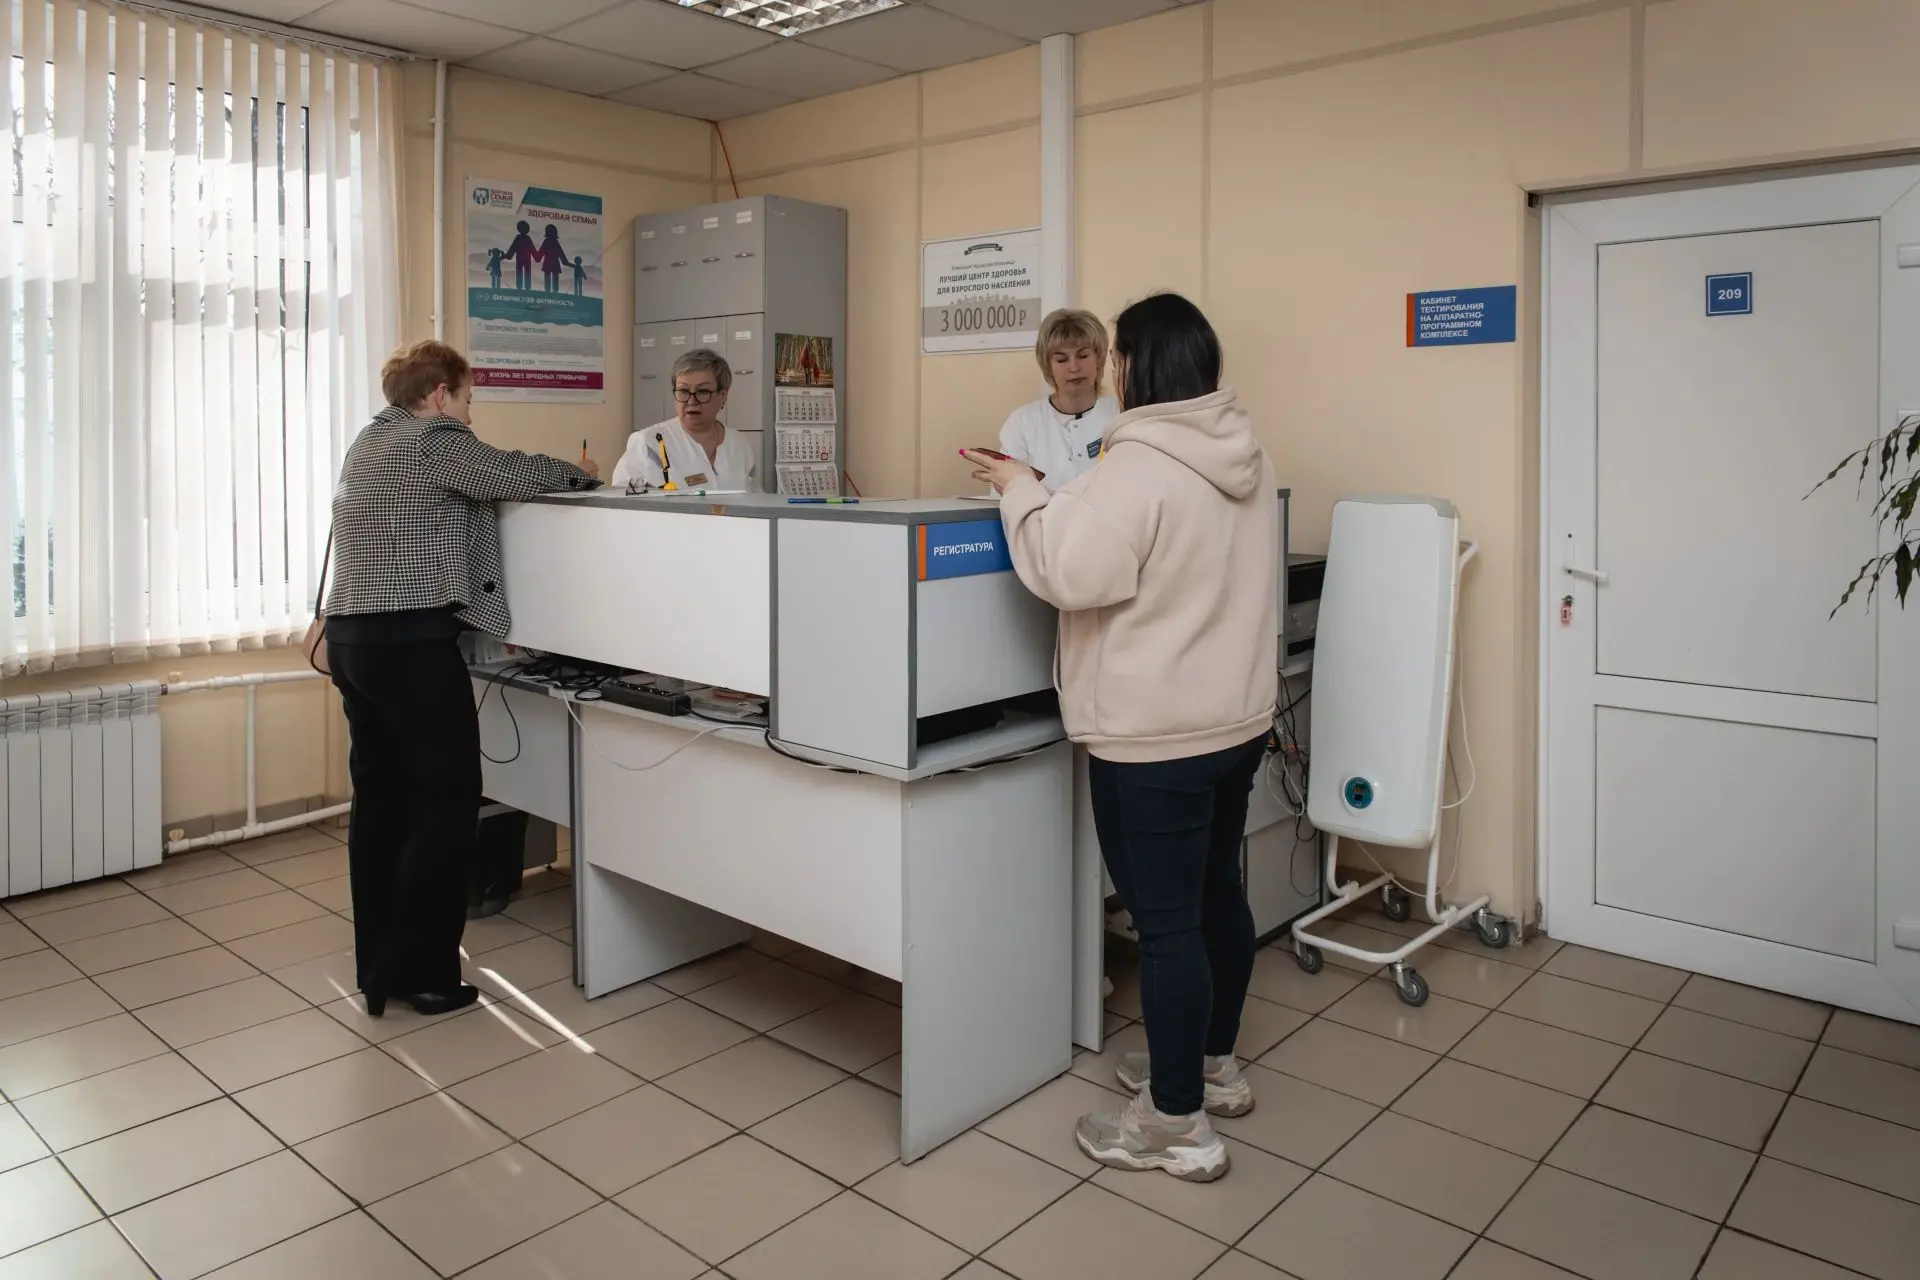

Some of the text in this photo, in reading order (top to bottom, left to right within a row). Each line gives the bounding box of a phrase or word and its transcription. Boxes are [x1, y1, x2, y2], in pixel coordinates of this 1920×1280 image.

[528, 209, 597, 225] ЗДОРОВАЯ СЕМЬЯ
[939, 268, 1027, 283] ЛУЧШИЙ ЦЕНТР ЗДОРОВЬЯ
[937, 279, 1031, 295] ДЛЯ ВЗРОСЛОГО НАСЕЛЕНИЯ
[1718, 288, 1742, 300] 209
[1420, 296, 1457, 305] КАБИНЕТ
[1420, 303, 1484, 313] ТЕСТИРОВАНИЯ
[941, 309, 949, 332] 3
[954, 307, 982, 331] 000
[987, 304, 1016, 329] 000
[1433, 311, 1484, 321] АППАРАТНО-
[1420, 320, 1482, 330] ПРОГРАММНОМ
[1420, 330, 1468, 339] КОМПЛЕКСЕ
[526, 372, 554, 380] ВРЕДНЫХ
[933, 541, 994, 557] РЕГИСТРАТУРА
